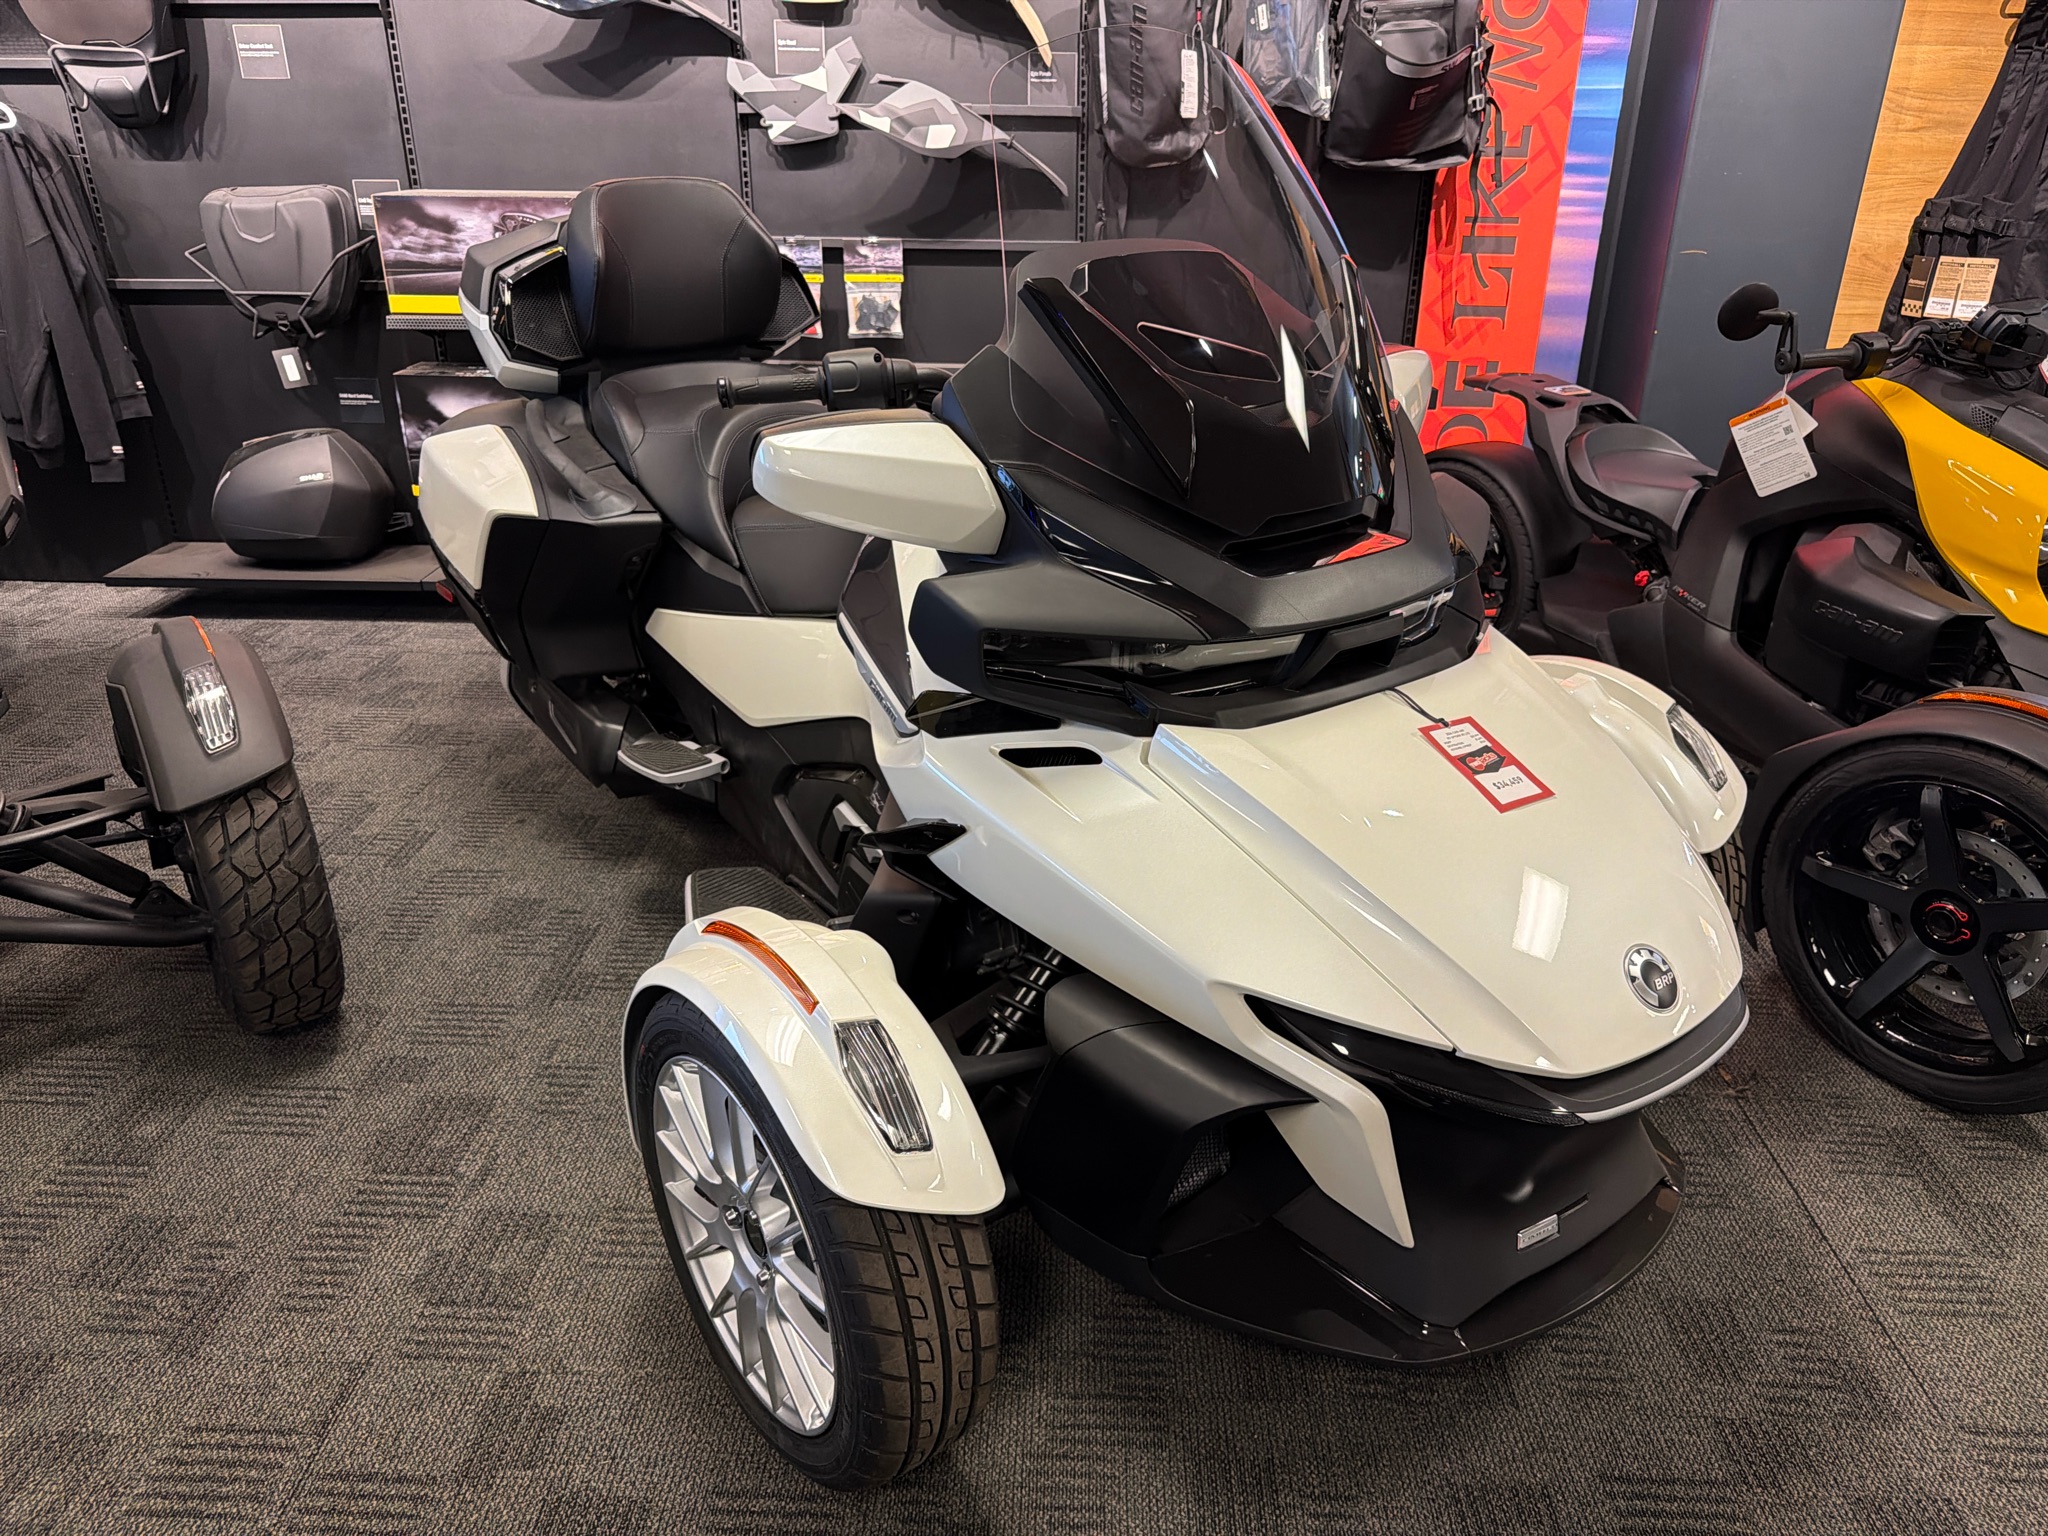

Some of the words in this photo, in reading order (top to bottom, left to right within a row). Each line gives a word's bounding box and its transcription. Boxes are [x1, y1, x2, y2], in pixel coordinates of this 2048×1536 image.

[1129, 3, 1147, 117] can-am
[1451, 125, 1532, 331] LIKE
[1812, 599, 1904, 643] can-am
[1492, 776, 1524, 790] $34,459
[1654, 971, 1674, 991] BRP
